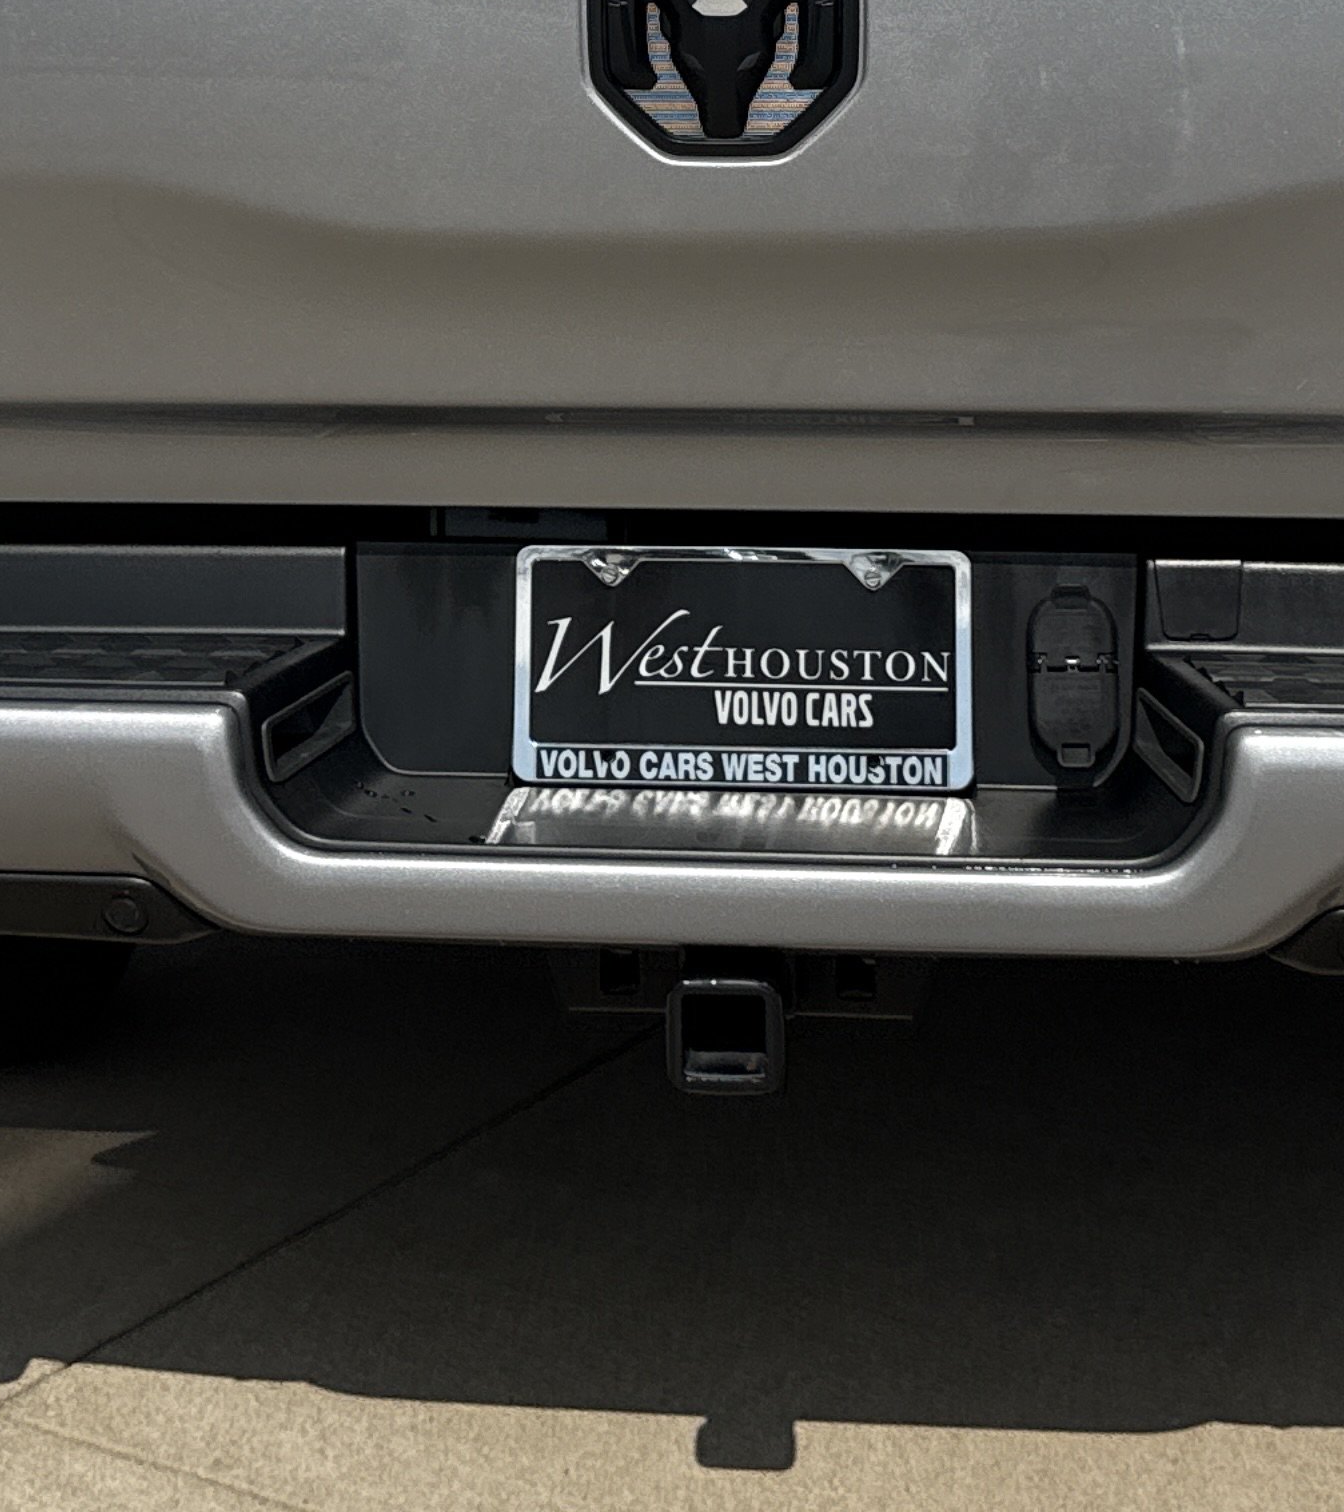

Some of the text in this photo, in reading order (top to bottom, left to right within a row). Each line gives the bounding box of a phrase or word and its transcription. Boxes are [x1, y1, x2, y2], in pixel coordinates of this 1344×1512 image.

[535, 609, 952, 695] West HOUSTON
[714, 689, 874, 728] VOLVO CARS
[539, 749, 943, 786] VOLVO CARS WEST HOUSTON
